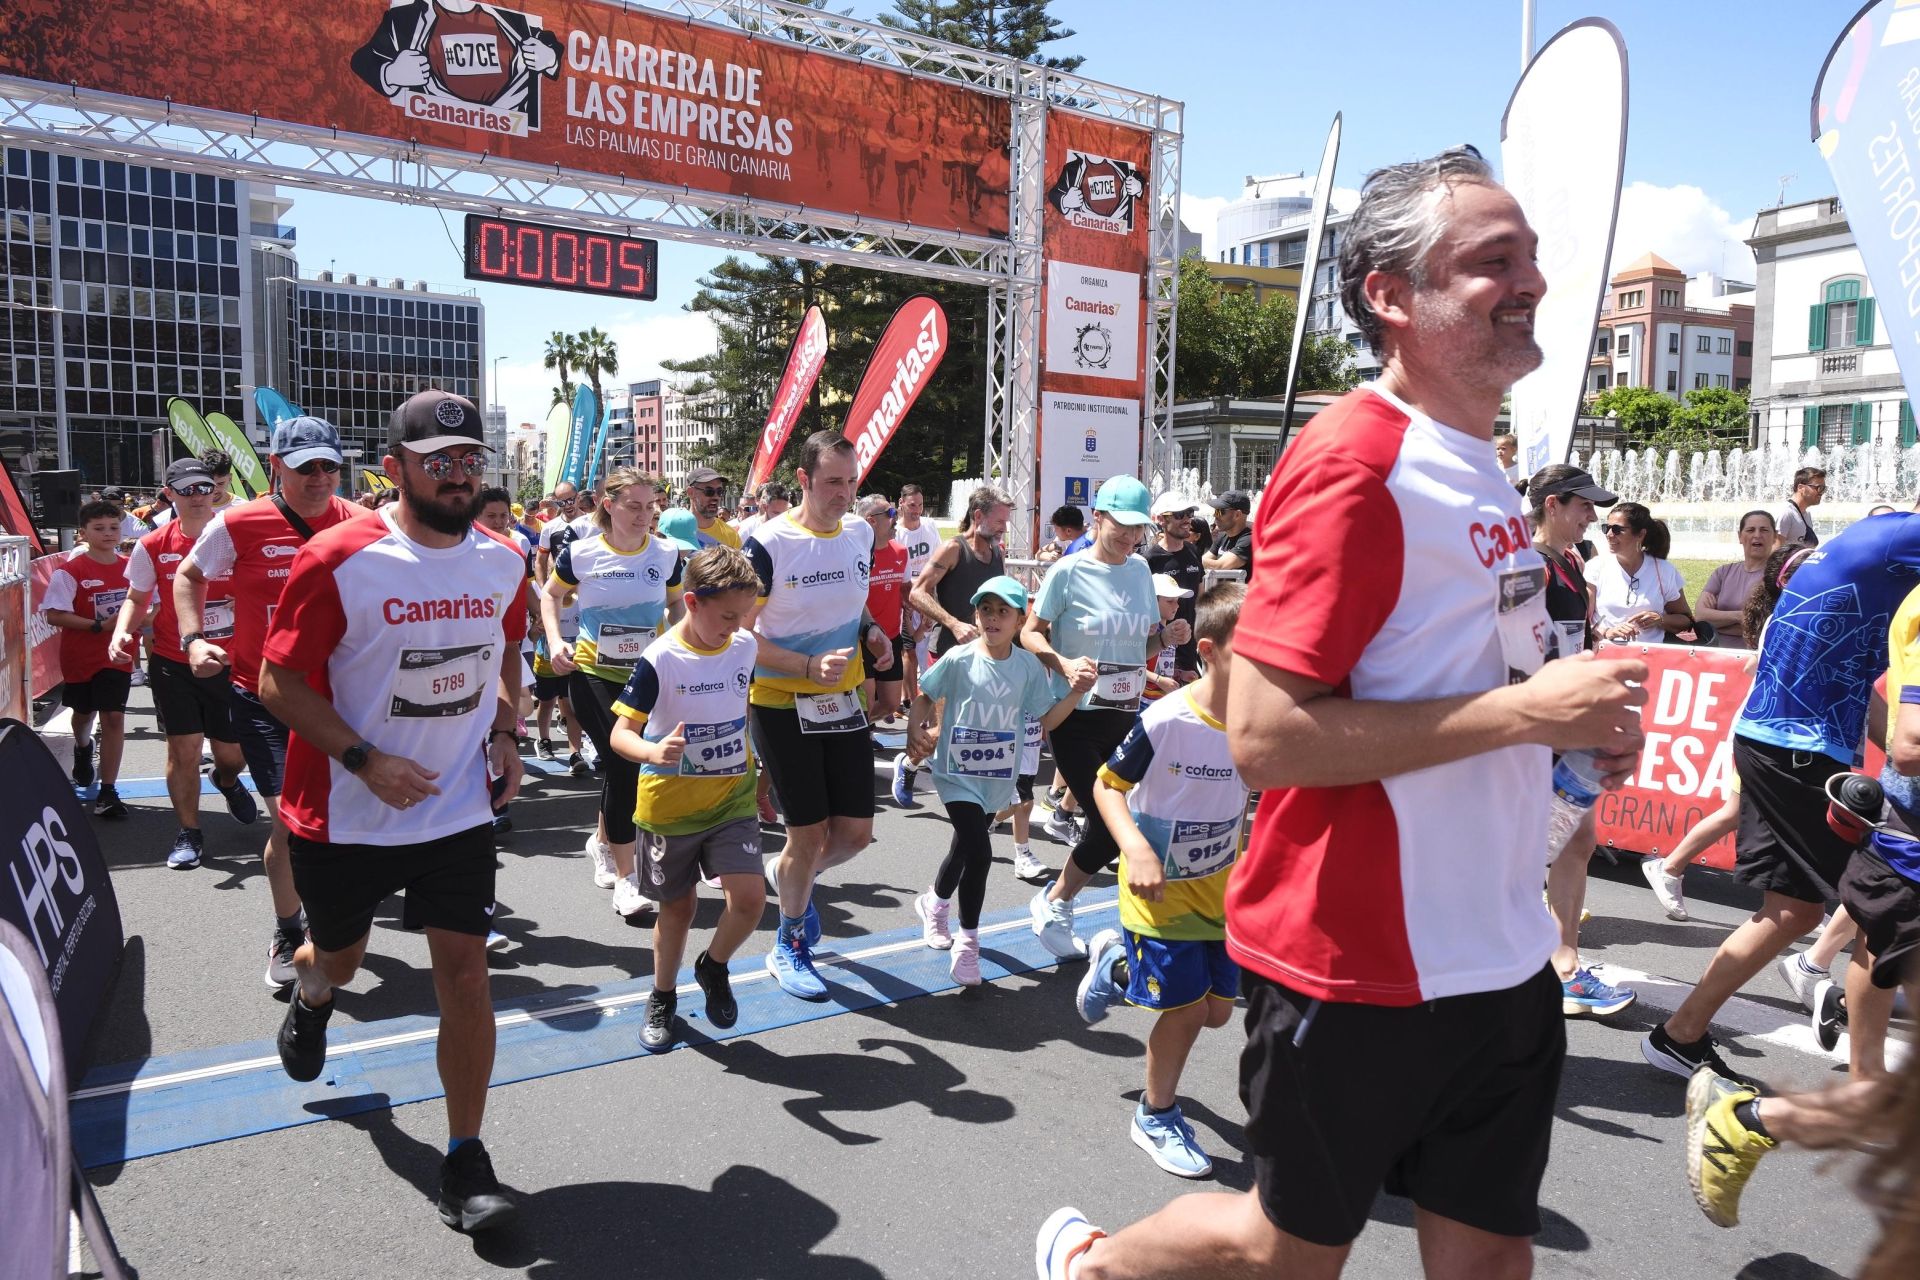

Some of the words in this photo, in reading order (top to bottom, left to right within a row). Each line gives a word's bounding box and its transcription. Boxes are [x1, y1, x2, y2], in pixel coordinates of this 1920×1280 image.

[444, 42, 499, 69] #C7CE
[567, 30, 718, 99] CARRERA
[725, 67, 762, 107] DE
[409, 94, 524, 134] Canarias7
[567, 76, 626, 125] LAS
[633, 94, 793, 155] EMPRESAS
[566, 123, 595, 148] LAS
[599, 127, 660, 158] PALMAS
[663, 141, 682, 162] DE
[685, 145, 726, 169] GRAN
[729, 154, 792, 182] CANARIA
[1090, 179, 1115, 196] #C7CE
[1073, 212, 1125, 233] Canarias7
[480, 222, 645, 292] 0:00:05
[1080, 276, 1108, 288] ORGANIZA
[1065, 296, 1120, 316] Canarias7
[856, 307, 941, 481] anarias7
[1053, 400, 1086, 412] PATROCINIO
[1087, 404, 1128, 415] INSTITUCIONAL
[802, 569, 845, 585] cofarca
[383, 592, 503, 625] Canarias7
[618, 642, 639, 653] 5259
[432, 672, 465, 695] 5789
[689, 682, 724, 693] cofarca
[1112, 682, 1131, 694] 3296
[817, 702, 839, 716] 5246
[1653, 669, 1726, 731] DE
[687, 725, 716, 737] HPS
[701, 738, 743, 761] 9152
[960, 748, 1005, 761] 9094
[1185, 764, 1232, 778] cofarca
[1601, 794, 1677, 836] GRAN
[1178, 824, 1210, 836] HPS
[9, 806, 84, 970] HPS
